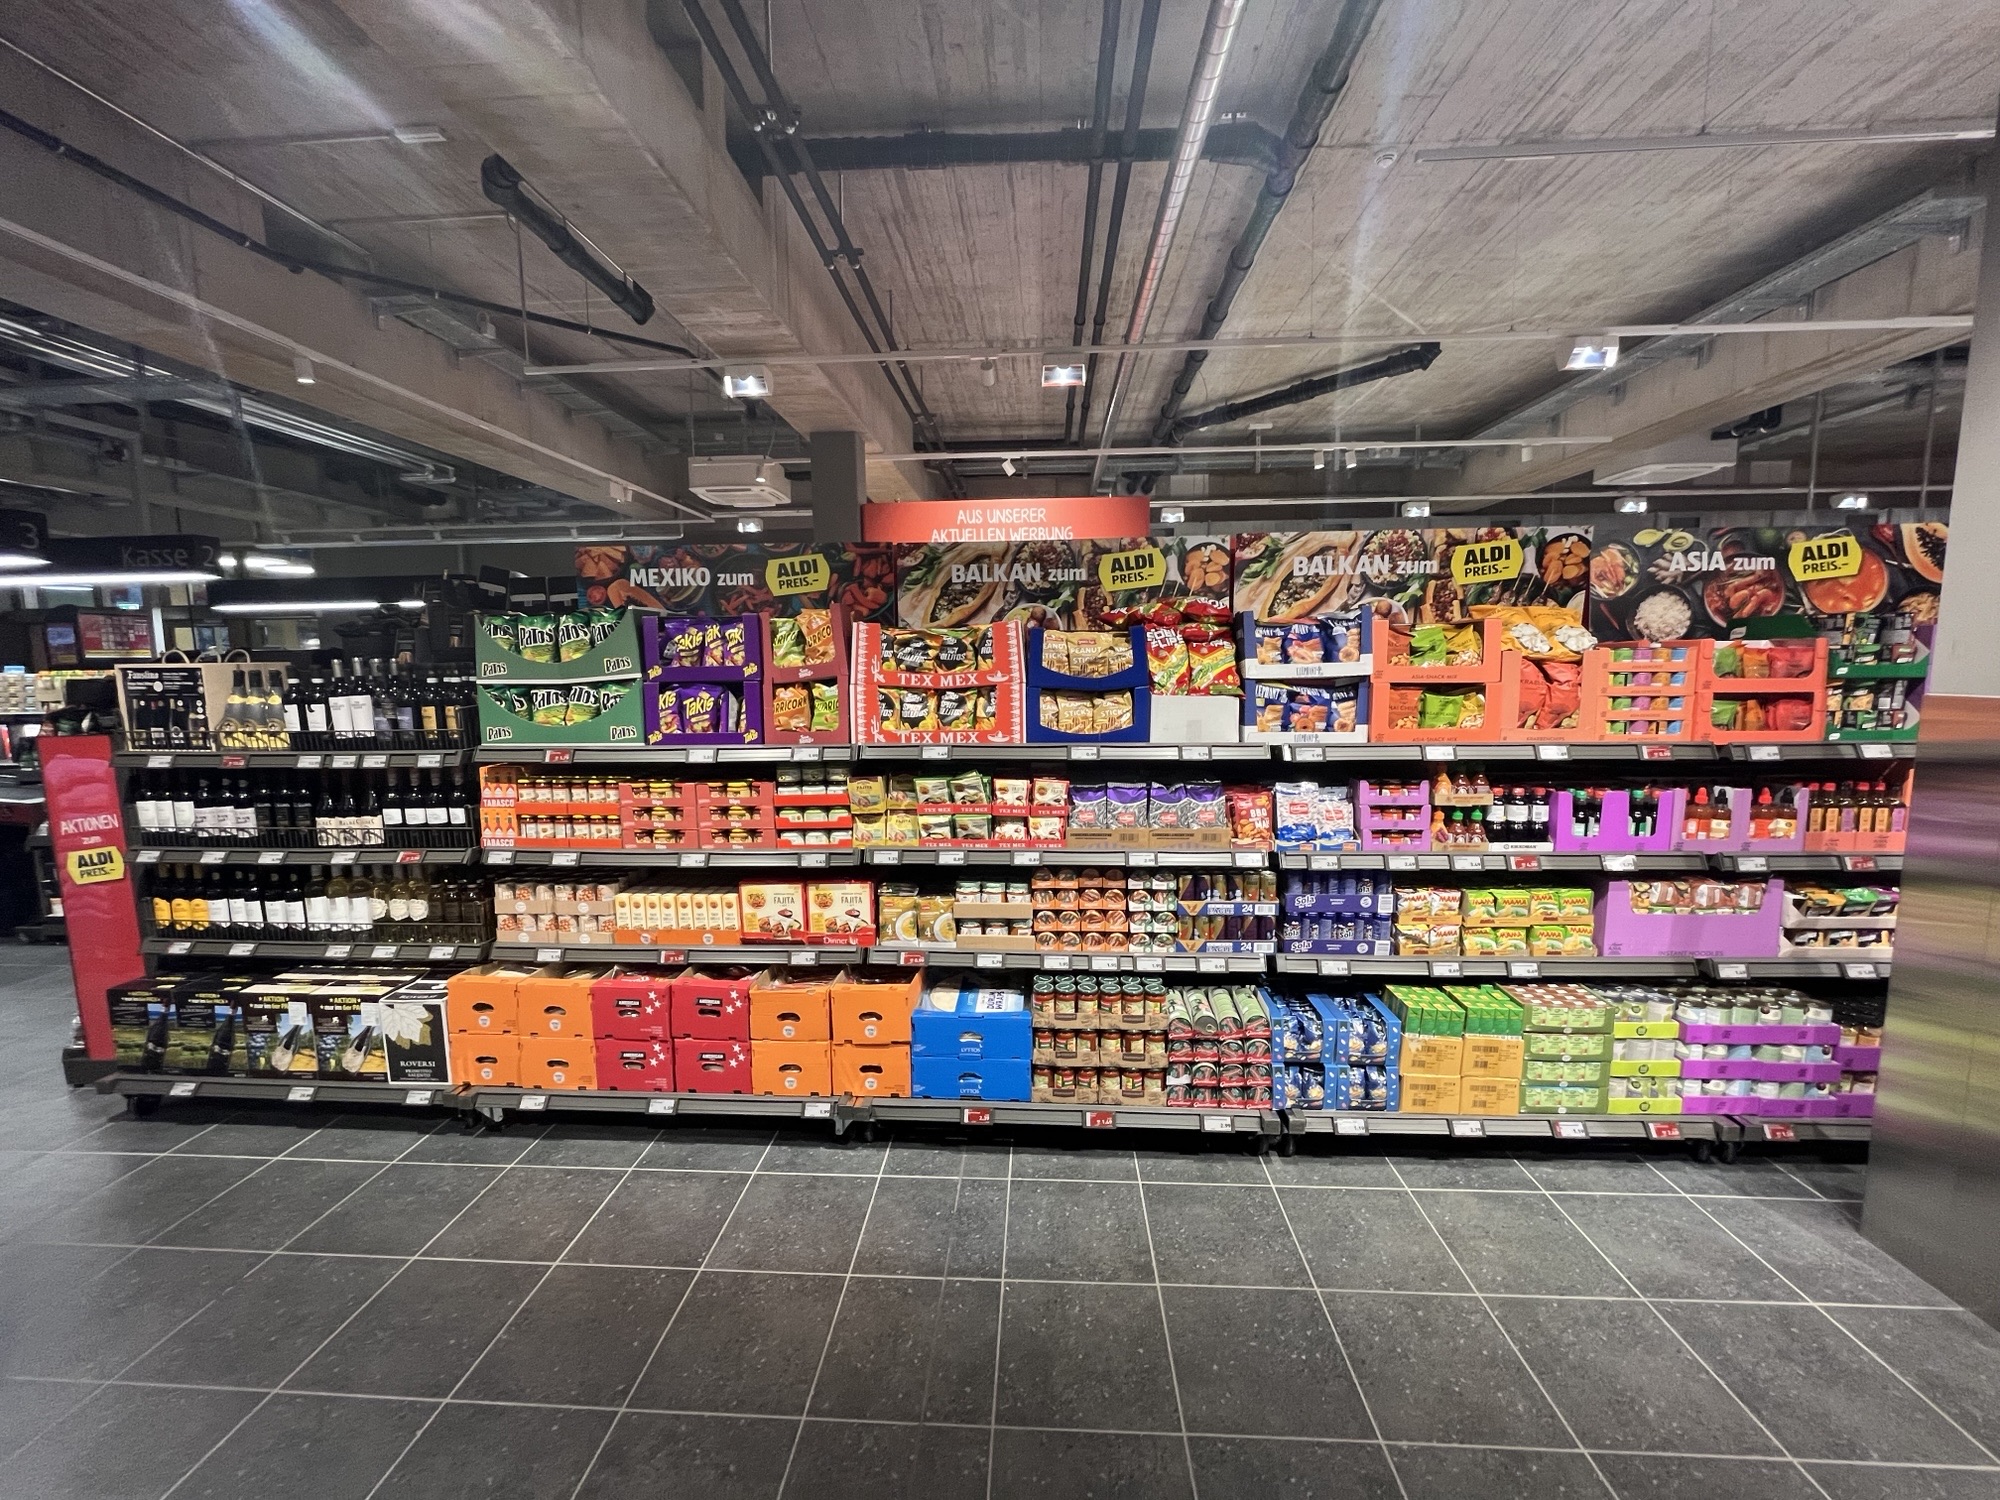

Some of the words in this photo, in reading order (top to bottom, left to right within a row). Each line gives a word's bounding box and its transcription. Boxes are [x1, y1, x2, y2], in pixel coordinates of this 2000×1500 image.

[957, 509, 983, 524] AUS
[987, 508, 1047, 523] UNSERER
[19, 522, 40, 549] 3
[931, 527, 1005, 543] AKTUELLEN
[1010, 526, 1073, 541] WERBUNG
[121, 546, 188, 568] Kasse
[203, 545, 216, 567] 2
[1463, 544, 1511, 565] ALDI
[1801, 541, 1849, 561] ALDI
[777, 559, 818, 578] ALDI
[1111, 553, 1154, 573] ALDI
[1293, 555, 1389, 576] BALKAN
[1396, 559, 1437, 574] zum
[1669, 551, 1726, 572] ASIA
[1733, 555, 1775, 571] zum
[629, 567, 711, 587] MEXIKO
[717, 572, 754, 586] zum
[951, 564, 1041, 583] BALKAN
[1048, 567, 1086, 581] zum
[559, 623, 591, 646] atos
[1070, 646, 1102, 654] PEANUT
[482, 662, 507, 676] Patos
[604, 657, 632, 672] Patos
[898, 673, 934, 687] TEX
[940, 672, 979, 687] MEX
[569, 686, 599, 705] atos
[684, 698, 714, 719] Takis
[487, 726, 512, 741] Patos
[610, 726, 637, 740] Patos
[898, 732, 935, 743] TEX
[940, 732, 980, 743] MEX
[482, 799, 515, 807] TABASCO
[1250, 808, 1267, 818] BBQ
[60, 813, 118, 835] AKTIONEN
[482, 839, 515, 847] TABASCO
[77, 851, 114, 868] ALDI
[773, 896, 795, 904] FAJITA
[841, 896, 863, 904] FAJITA
[1295, 895, 1316, 905] Sola
[1241, 904, 1253, 912] 24
[1435, 930, 1458, 938] MAMA
[1570, 926, 1593, 935] MAMA
[823, 936, 848, 945] Dinner
[1240, 942, 1252, 950] 24
[1291, 941, 1312, 950] Sola
